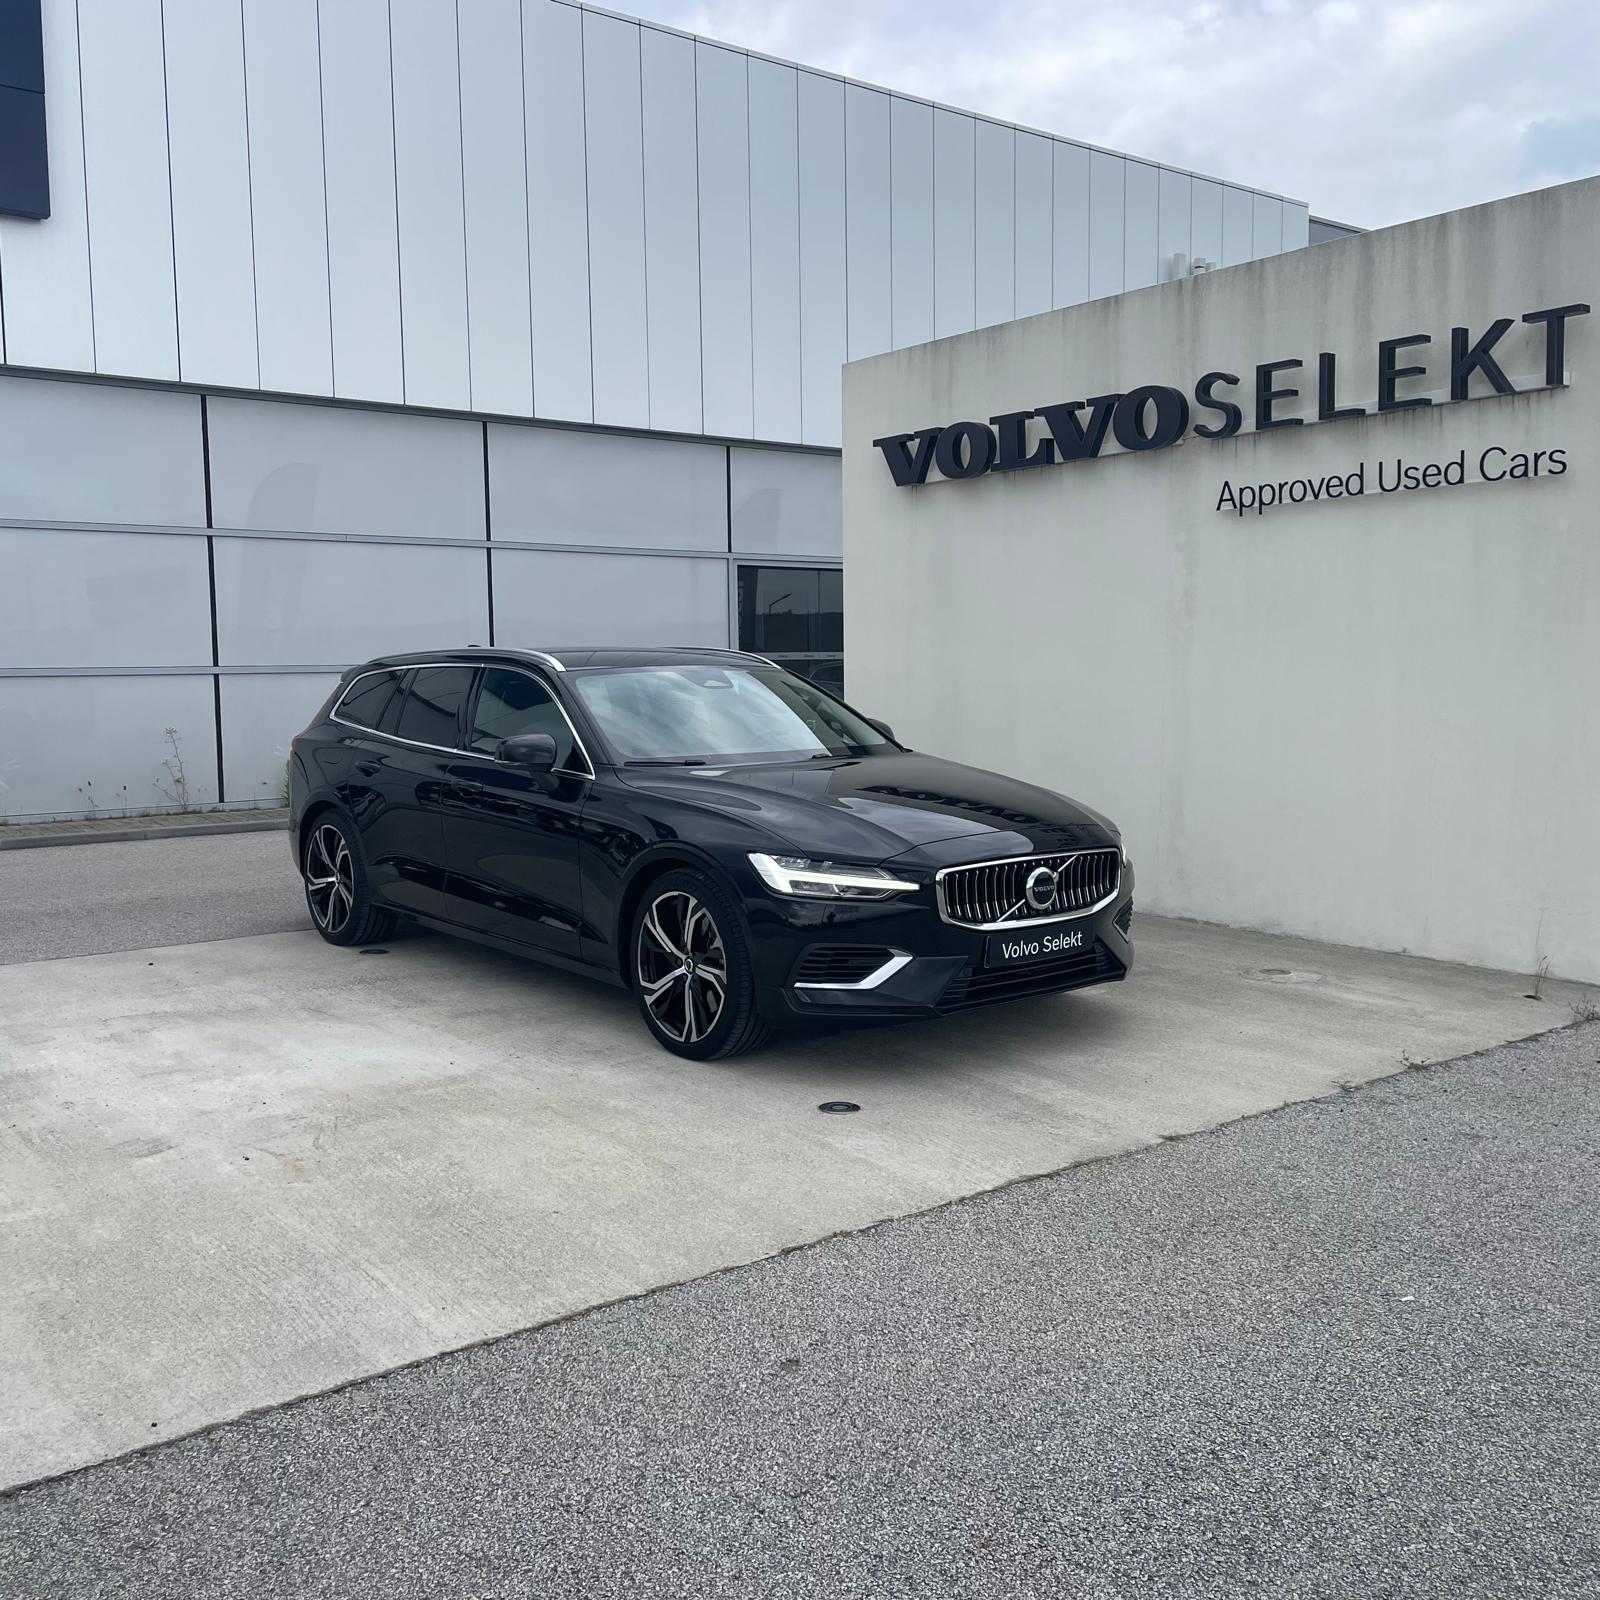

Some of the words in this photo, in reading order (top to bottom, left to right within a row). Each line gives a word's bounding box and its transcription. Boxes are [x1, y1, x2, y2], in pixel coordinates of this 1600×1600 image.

[1216, 462, 1365, 517] Approved
[1378, 450, 1465, 493] Used
[1479, 446, 1567, 482] Cars
[1033, 885, 1055, 893] VOLVO
[1002, 940, 1039, 959] Volvo
[1043, 930, 1083, 952] Selekt
